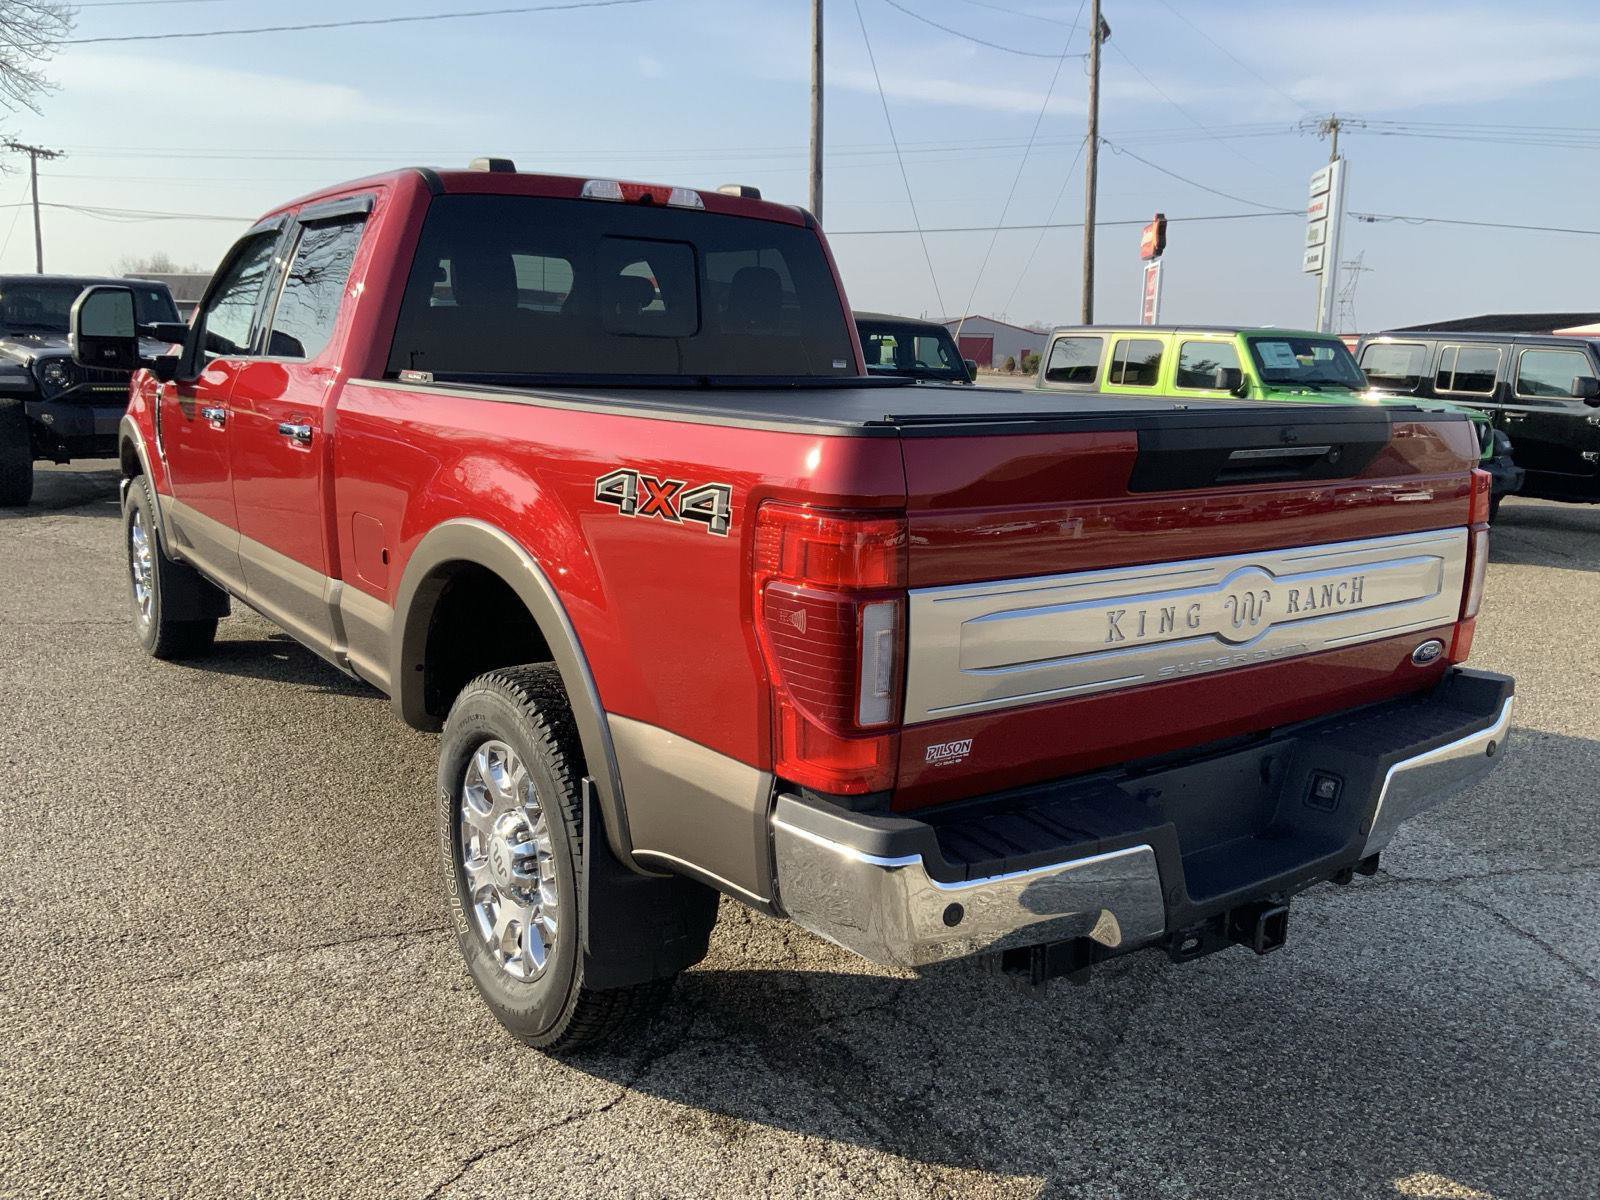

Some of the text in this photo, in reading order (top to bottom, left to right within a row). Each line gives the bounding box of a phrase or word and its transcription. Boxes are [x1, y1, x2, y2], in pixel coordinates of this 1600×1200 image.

[1104, 603, 1200, 643] KING
[1286, 575, 1365, 613] RANCH
[926, 739, 972, 760] PILSON
[441, 786, 470, 934] MICHELIN
